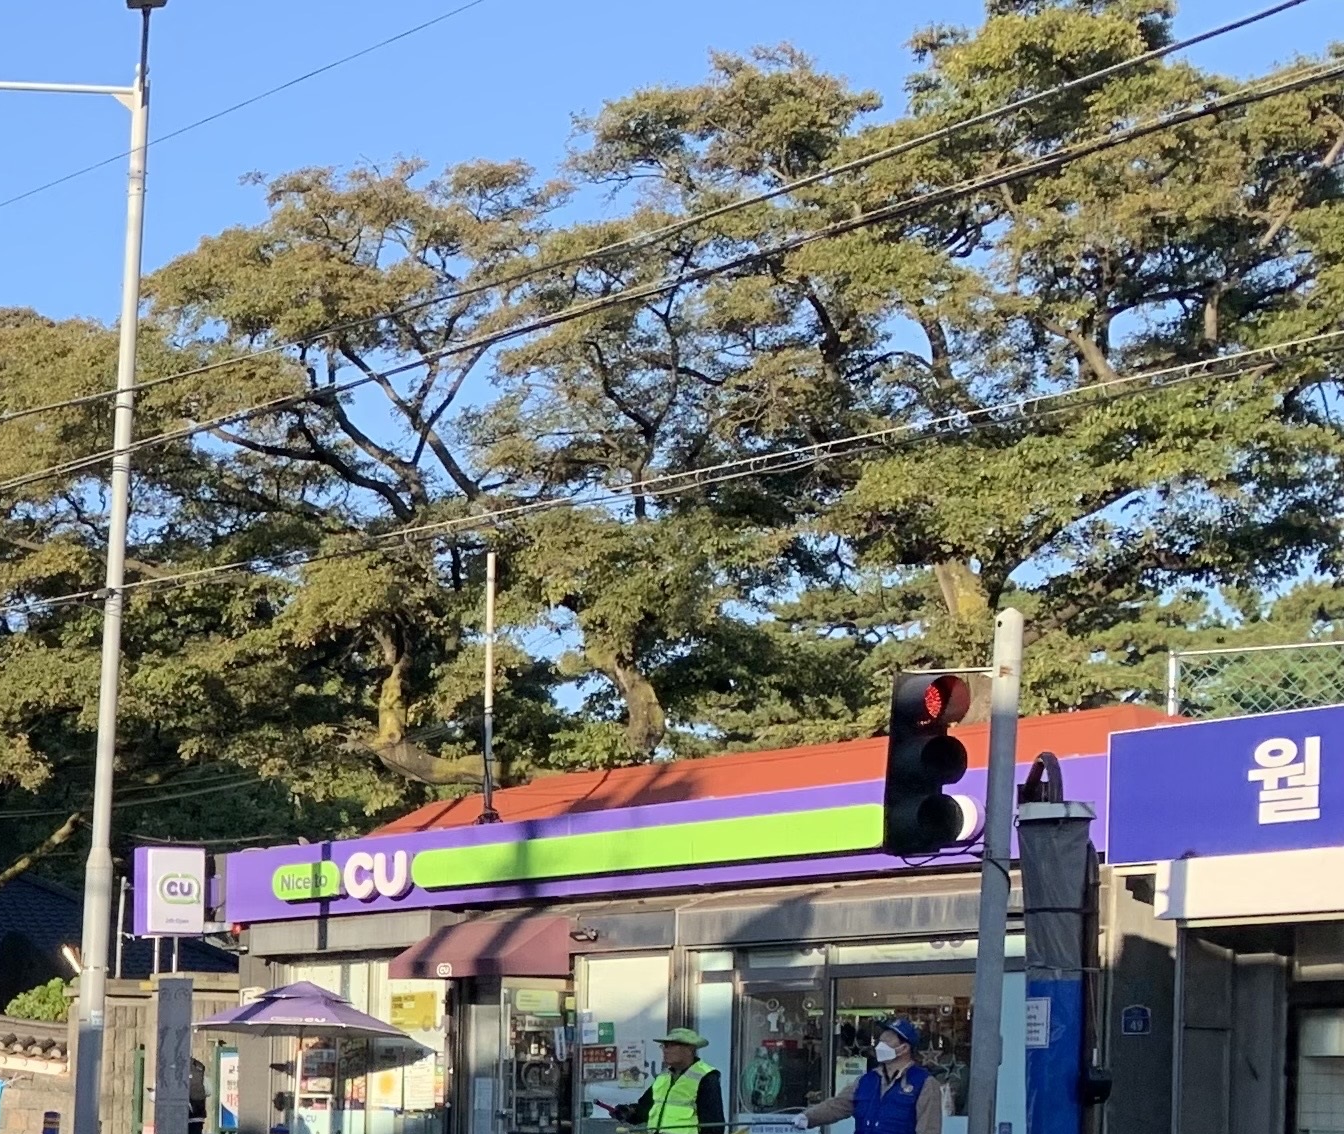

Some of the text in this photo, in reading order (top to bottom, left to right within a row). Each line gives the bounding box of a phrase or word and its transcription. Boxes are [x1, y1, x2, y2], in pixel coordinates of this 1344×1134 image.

[1247, 736, 1321, 825] 월
[166, 880, 193, 897] CU
[280, 849, 409, 901] Nice to CU
[1130, 1019, 1144, 1032] 49
